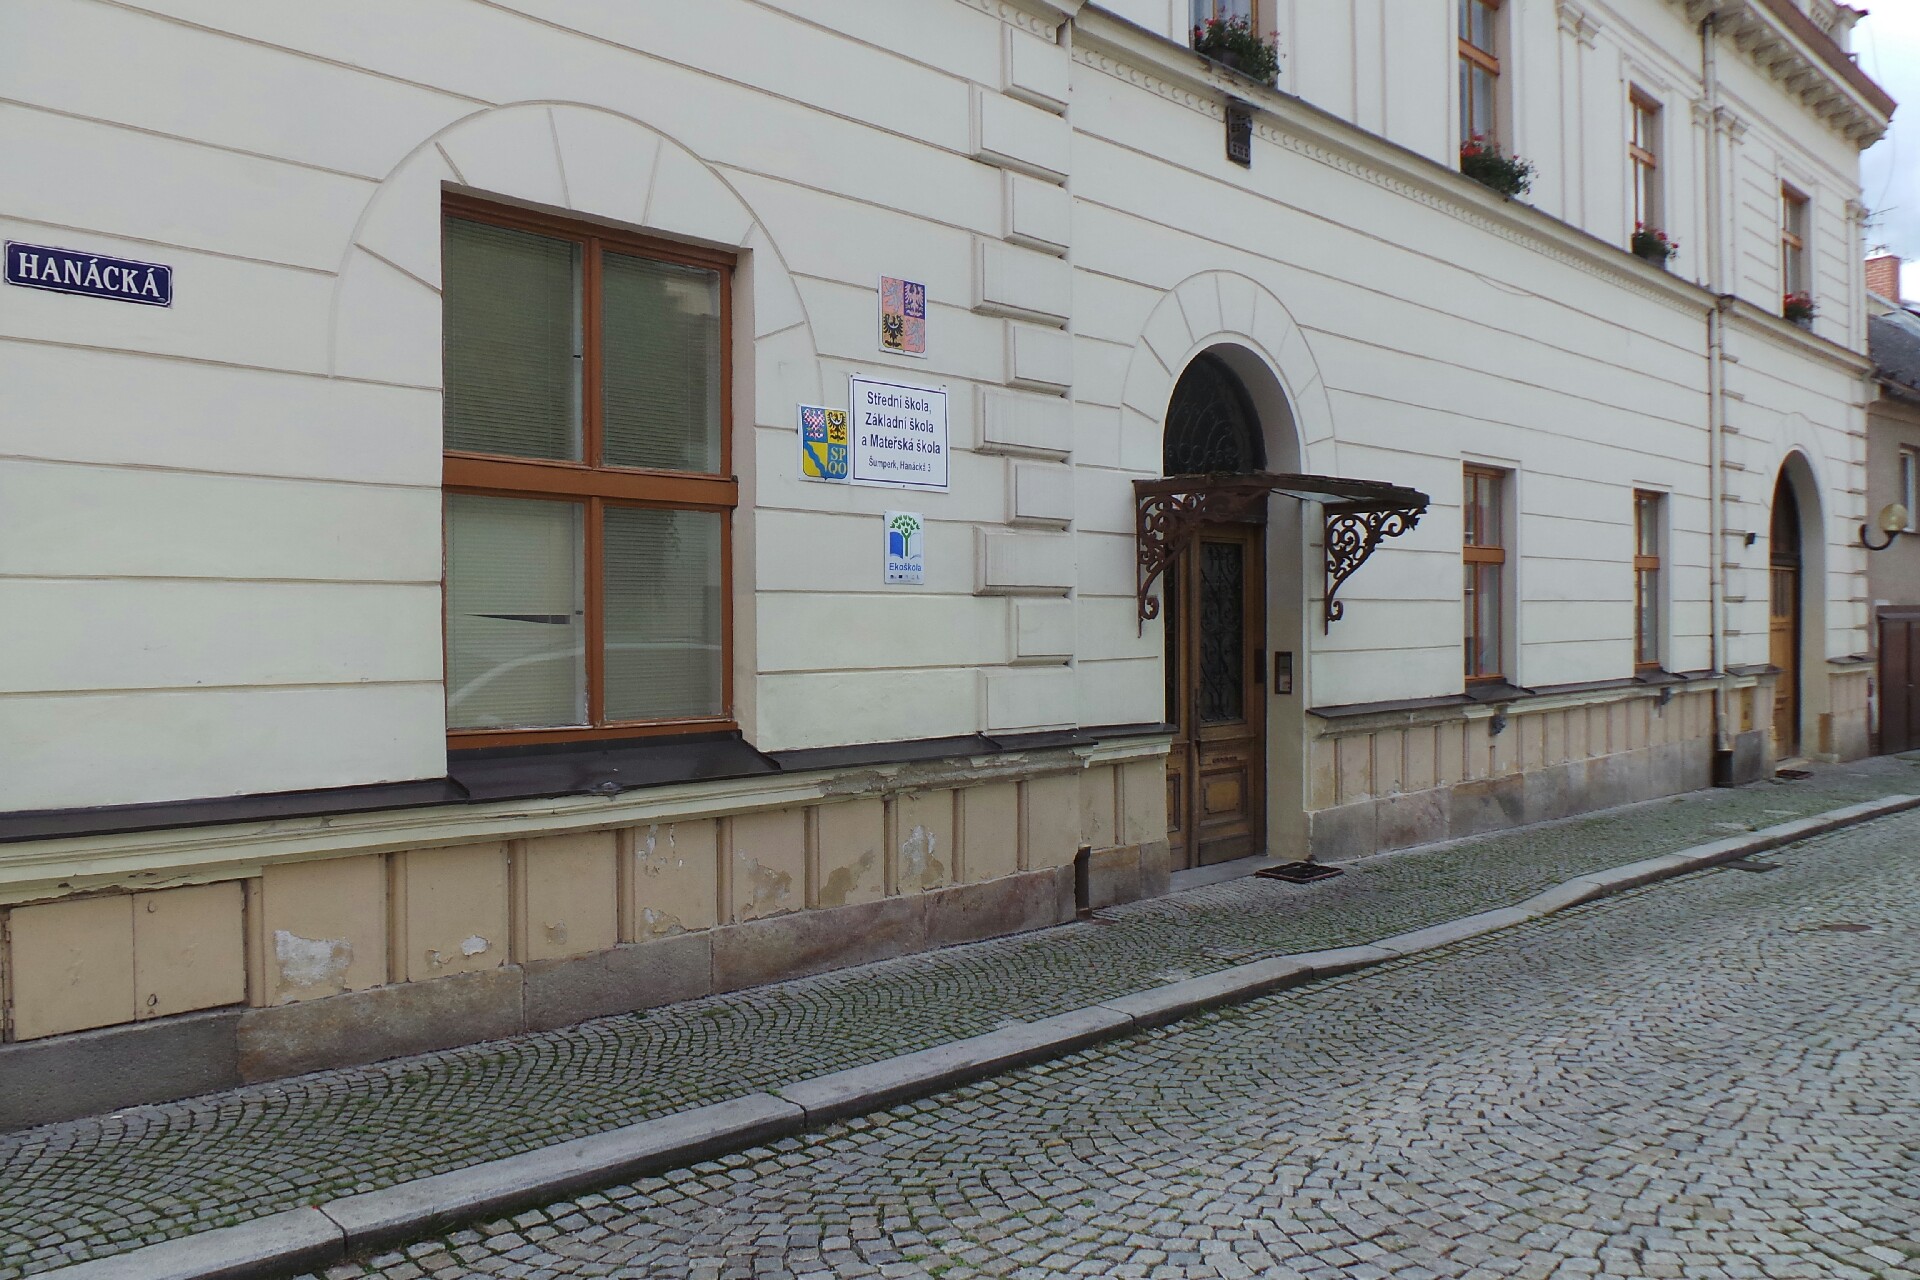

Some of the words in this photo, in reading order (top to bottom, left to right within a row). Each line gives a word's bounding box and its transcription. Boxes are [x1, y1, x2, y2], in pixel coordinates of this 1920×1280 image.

[18, 252, 161, 298] HANÁCKÁ
[867, 391, 902, 409] Střední
[904, 396, 932, 414] škola,
[865, 412, 907, 430] Základní
[909, 417, 934, 433] škola
[830, 446, 846, 461] SP
[861, 435, 867, 446] a
[870, 433, 914, 451] Mateřská
[916, 438, 941, 454] škola
[868, 455, 899, 471] Šumperk,
[899, 460, 926, 472] Hanácká
[889, 562, 922, 572] Ekoškola
